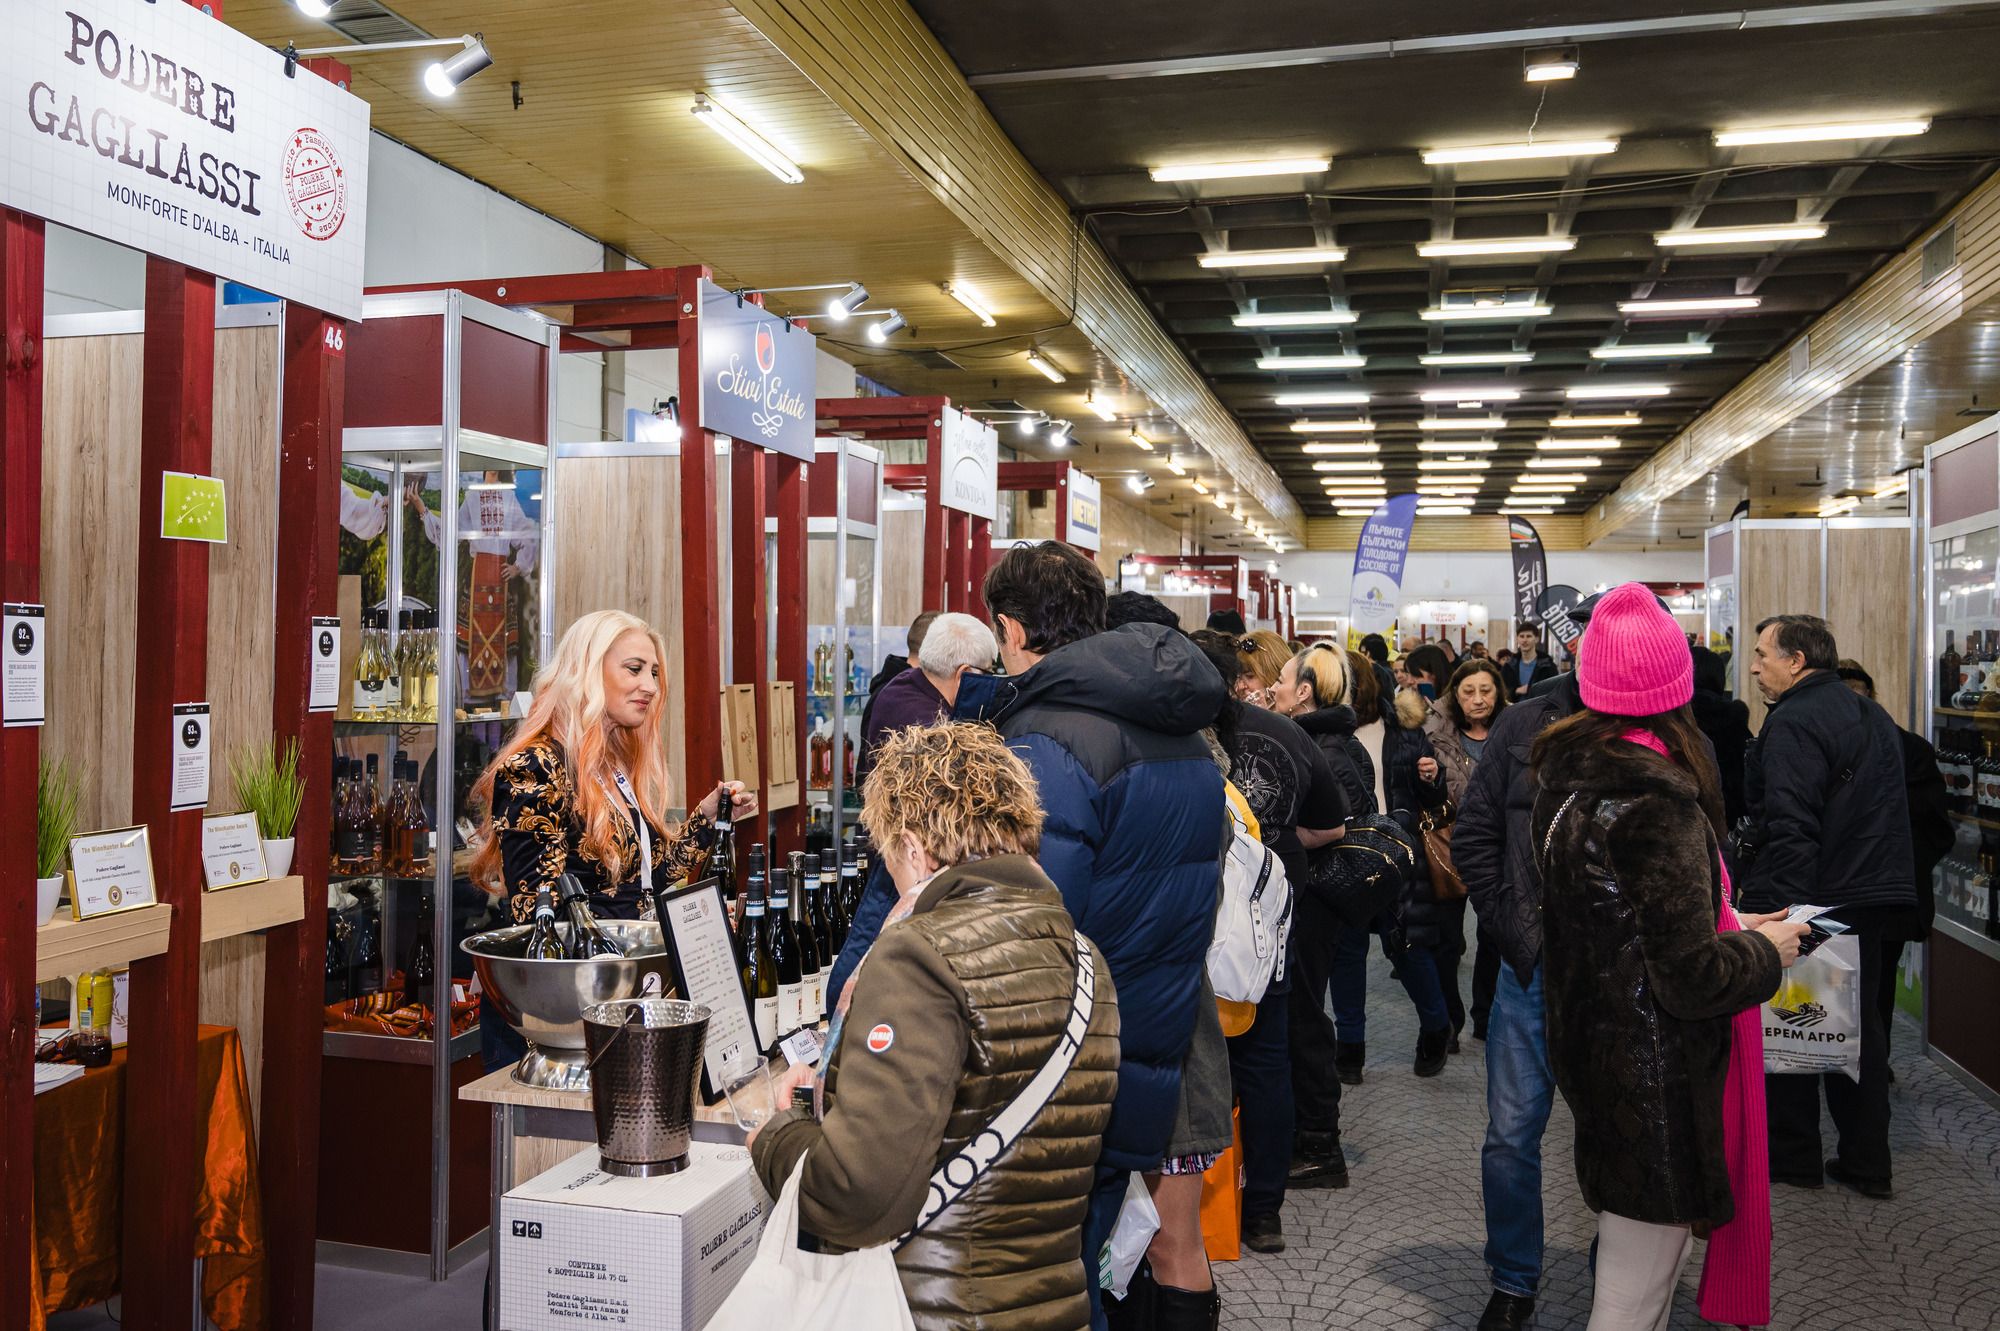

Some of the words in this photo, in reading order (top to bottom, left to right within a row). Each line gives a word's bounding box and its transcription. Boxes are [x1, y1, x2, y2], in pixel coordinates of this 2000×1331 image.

[65, 11, 235, 133] PODERE
[29, 81, 261, 216] GAGLIASSI
[107, 181, 188, 228] MONFORTE
[193, 213, 240, 246] D'ALBA
[253, 236, 291, 265] ITALIA
[325, 326, 344, 350] 46
[717, 353, 763, 403] Stivi
[766, 376, 807, 420] Estate
[1368, 524, 1404, 539] ПЪРВИТЕ
[1361, 535, 1406, 551] БЪЛГАРСКИ
[1363, 547, 1400, 562] ПЛОДОВИ
[1358, 559, 1388, 573] СОСОВЕ
[1389, 563, 1401, 574] ОТ
[1762, 1027, 1804, 1040] ЕРЕМ
[1807, 1032, 1846, 1043] АГРО
[700, 1229, 728, 1260] PODERE
[729, 1201, 762, 1237] GAGLIASSI
[567, 1260, 607, 1271] CONTIENE
[554, 1267, 595, 1279] BOTTIGLIE
[597, 1272, 607, 1281] DA
[608, 1273, 617, 1281] 75
[618, 1275, 628, 1283] CL
[546, 1291, 571, 1300] Podere
[550, 1307, 583, 1318] Monforte
